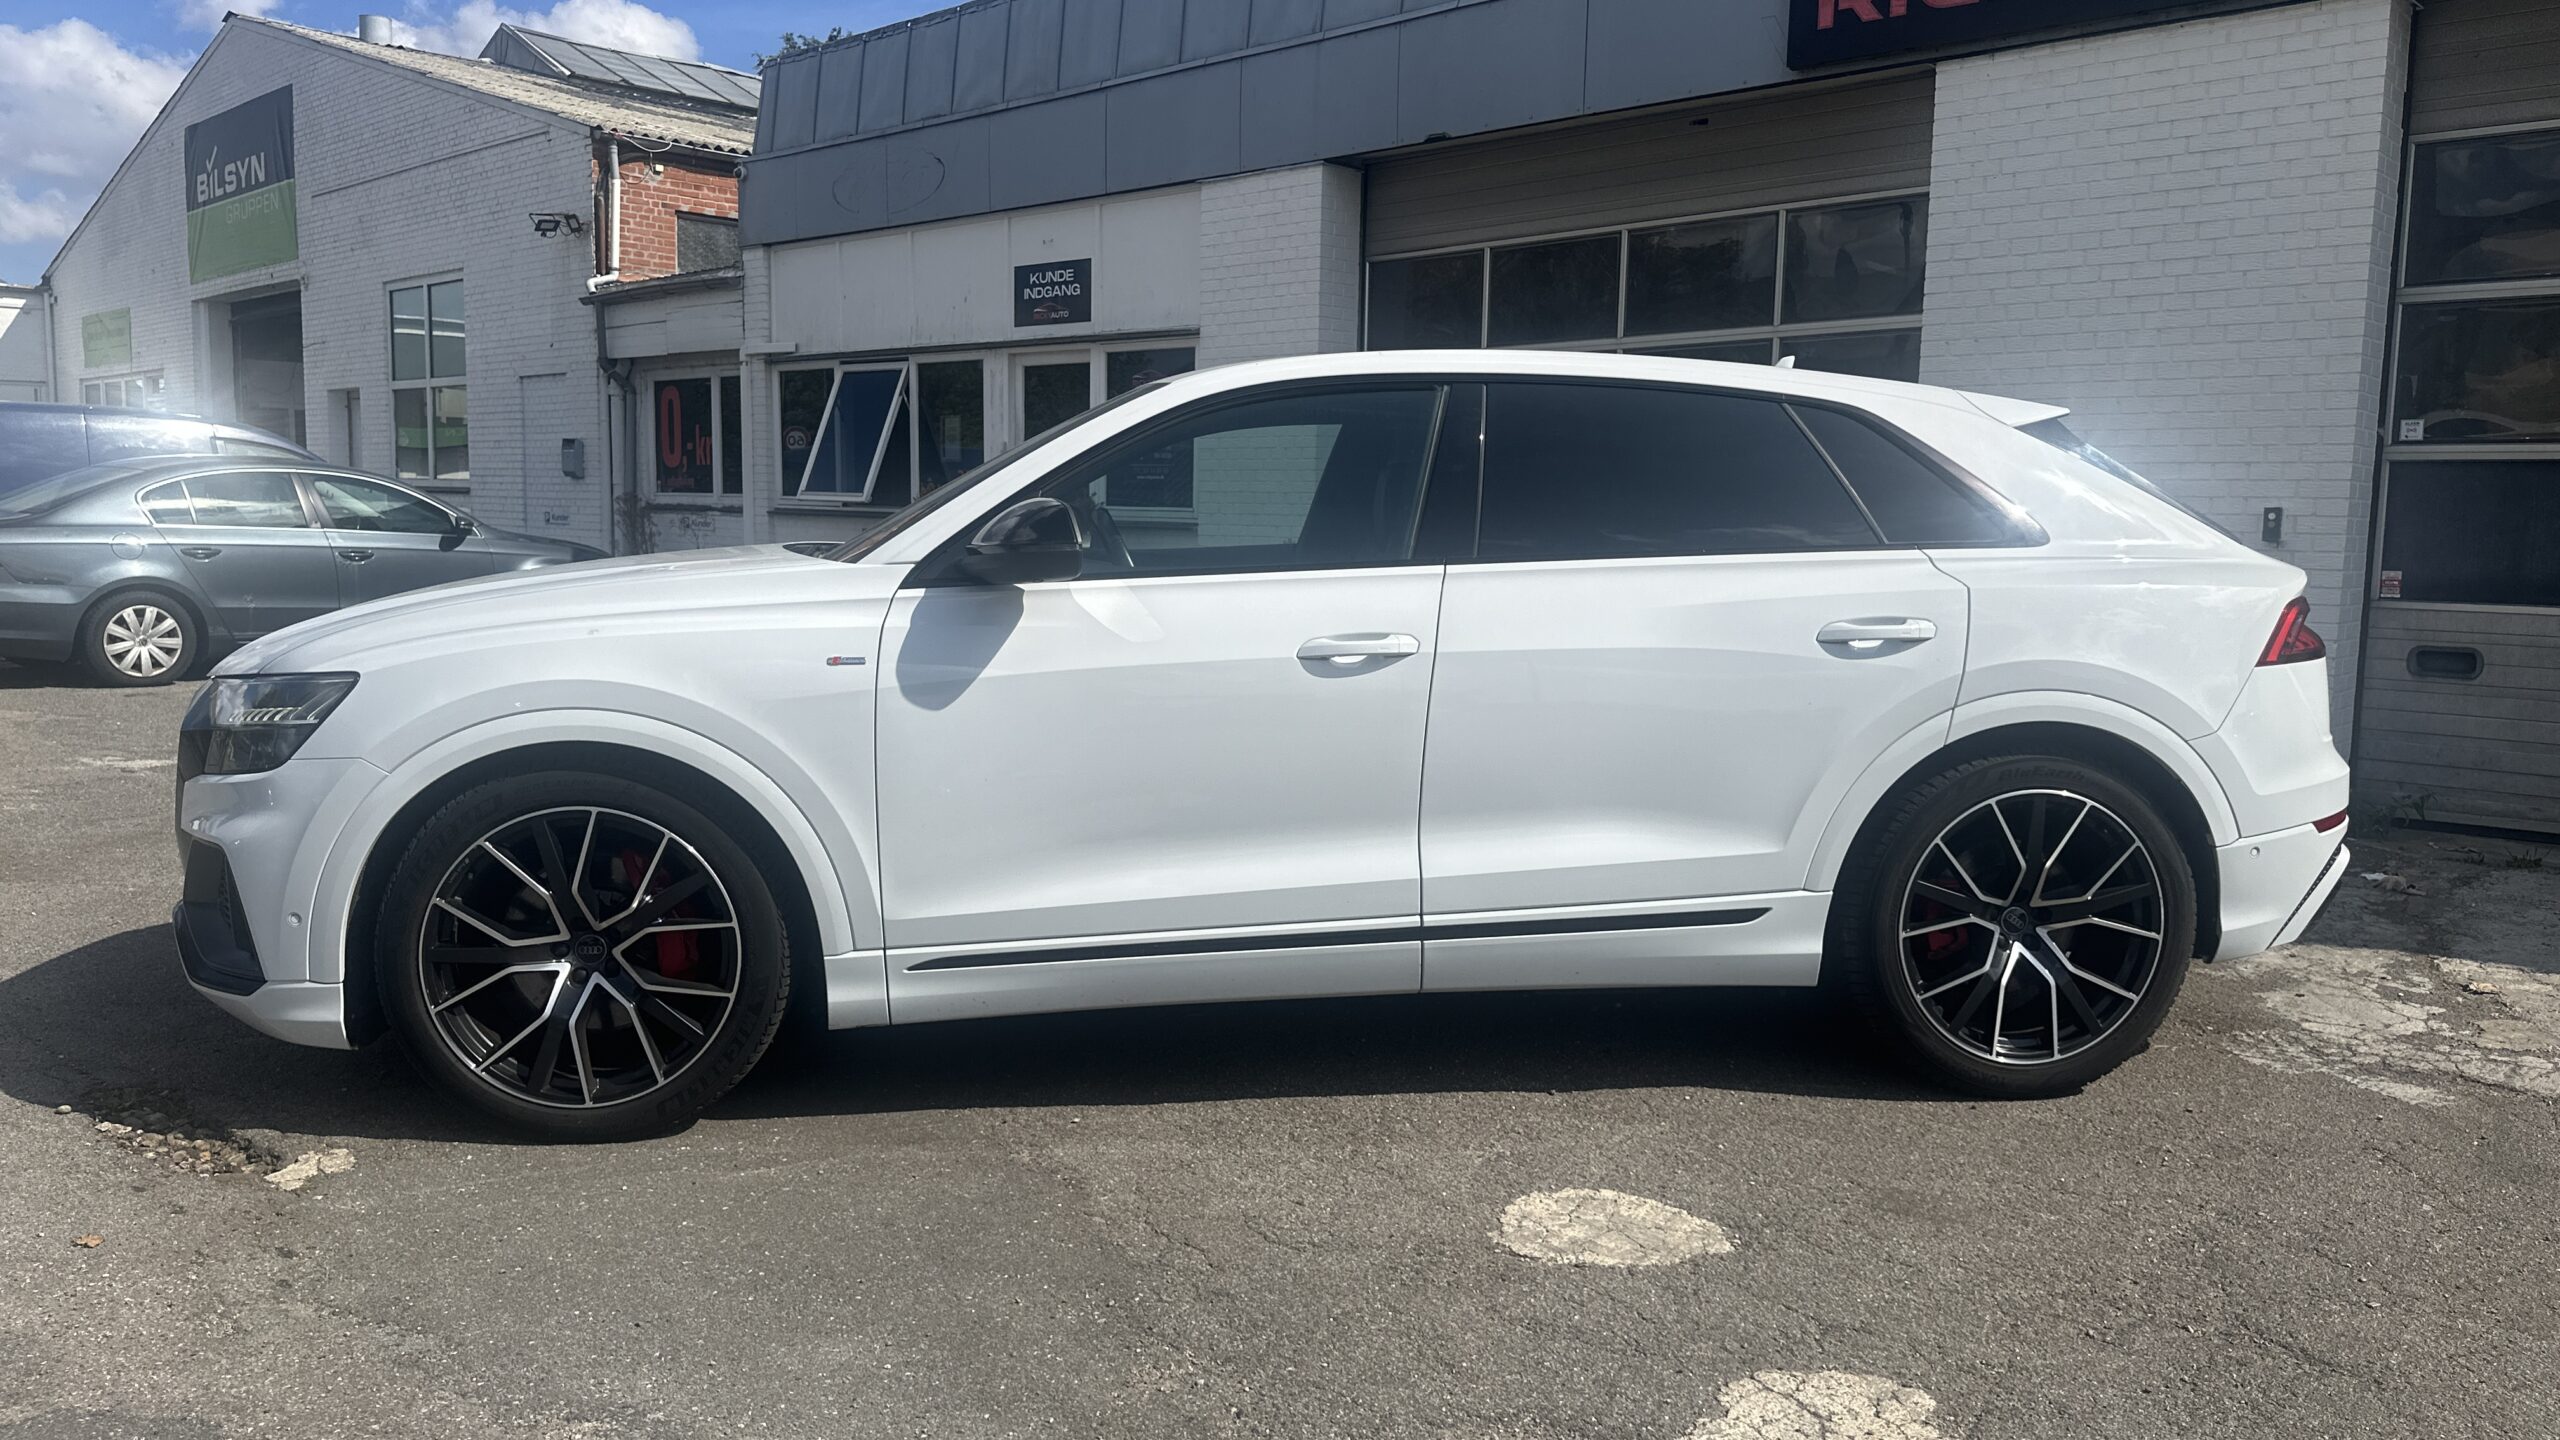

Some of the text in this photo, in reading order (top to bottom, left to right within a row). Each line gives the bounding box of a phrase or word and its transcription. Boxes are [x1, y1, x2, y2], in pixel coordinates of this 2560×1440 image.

[196, 151, 266, 203] BILSYN
[225, 191, 279, 224] GRUPPEN
[1030, 268, 1075, 285] KUNDE
[1023, 283, 1081, 300] INDGANG
